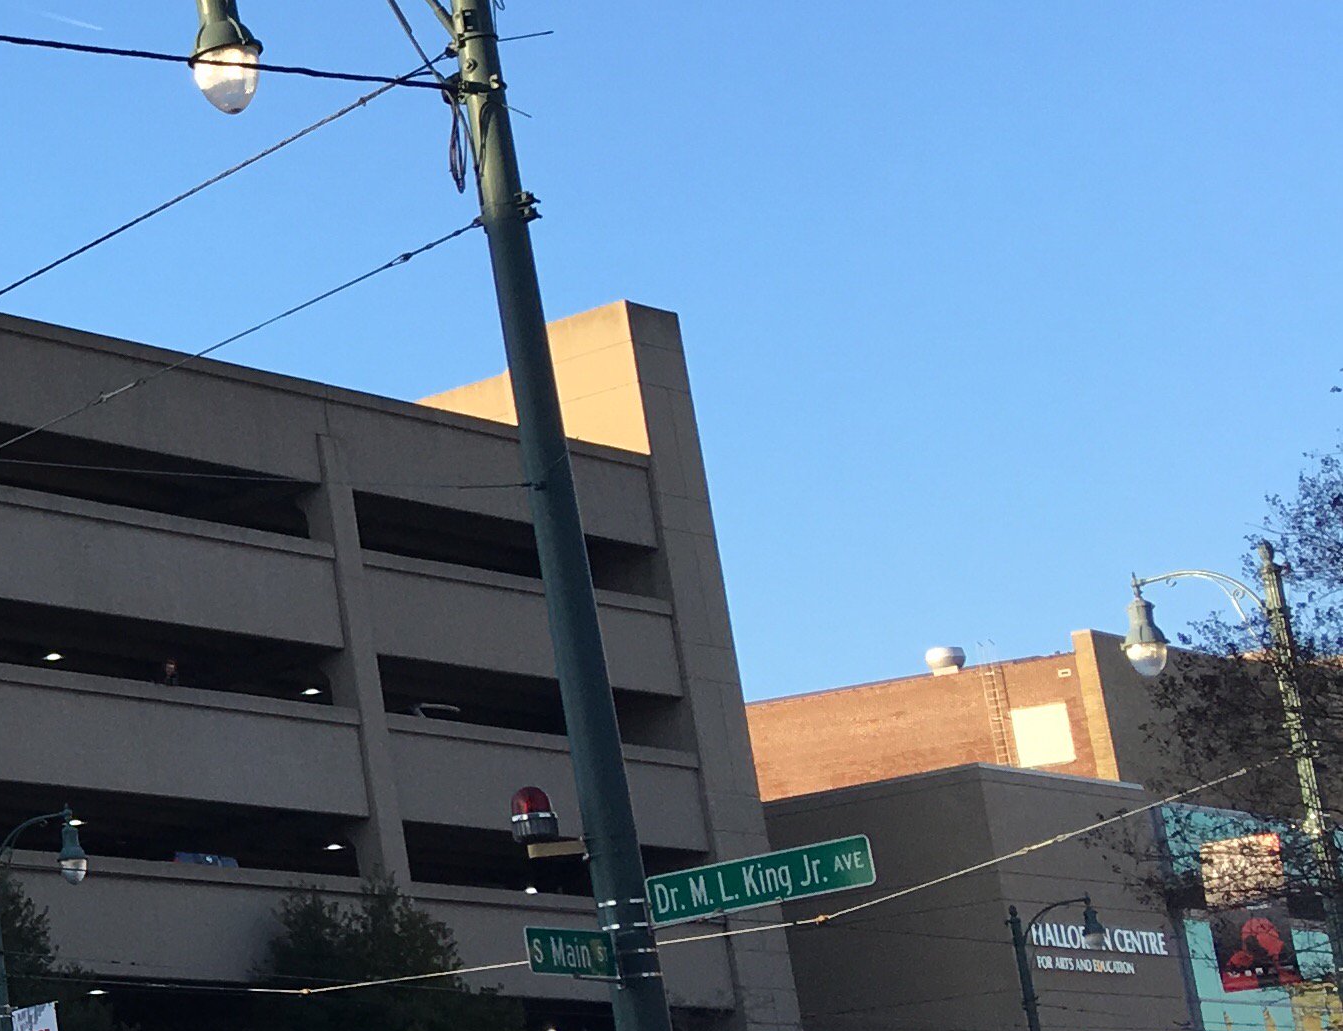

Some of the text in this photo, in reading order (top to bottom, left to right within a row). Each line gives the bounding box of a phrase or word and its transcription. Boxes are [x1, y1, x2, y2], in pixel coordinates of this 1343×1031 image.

[654, 851, 864, 914] Dr. M. L. King Jr. AVE
[532, 936, 608, 968] S Main ST
[1115, 928, 1169, 955] CENTRE
[1036, 955, 1136, 975] FOR ARTS AND EDUCATION
